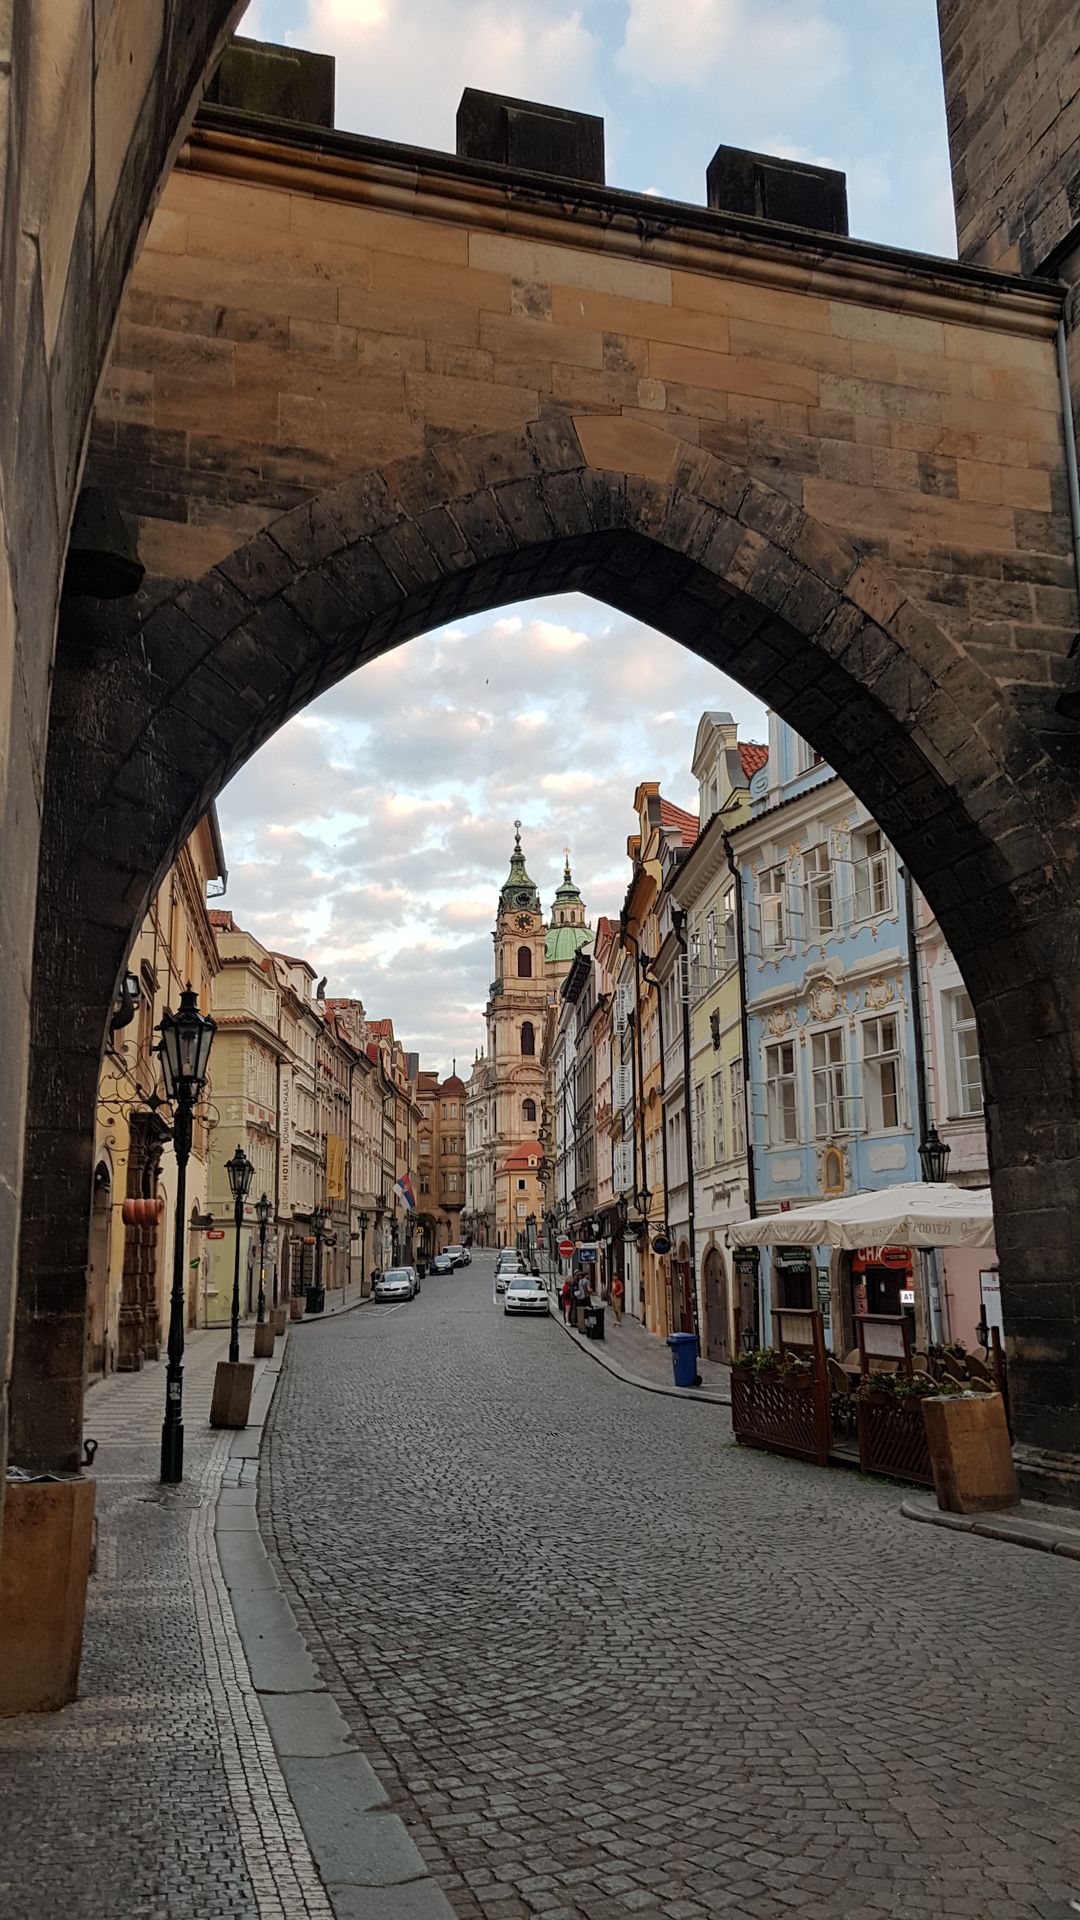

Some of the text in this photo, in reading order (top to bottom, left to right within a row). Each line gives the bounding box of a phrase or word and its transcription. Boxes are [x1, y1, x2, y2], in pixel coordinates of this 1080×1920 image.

[282, 1117, 290, 1144] DOMUS
[281, 1181, 289, 1210] DESIGN
[740, 1266, 753, 1274] WC
[791, 1265, 805, 1273] WC
